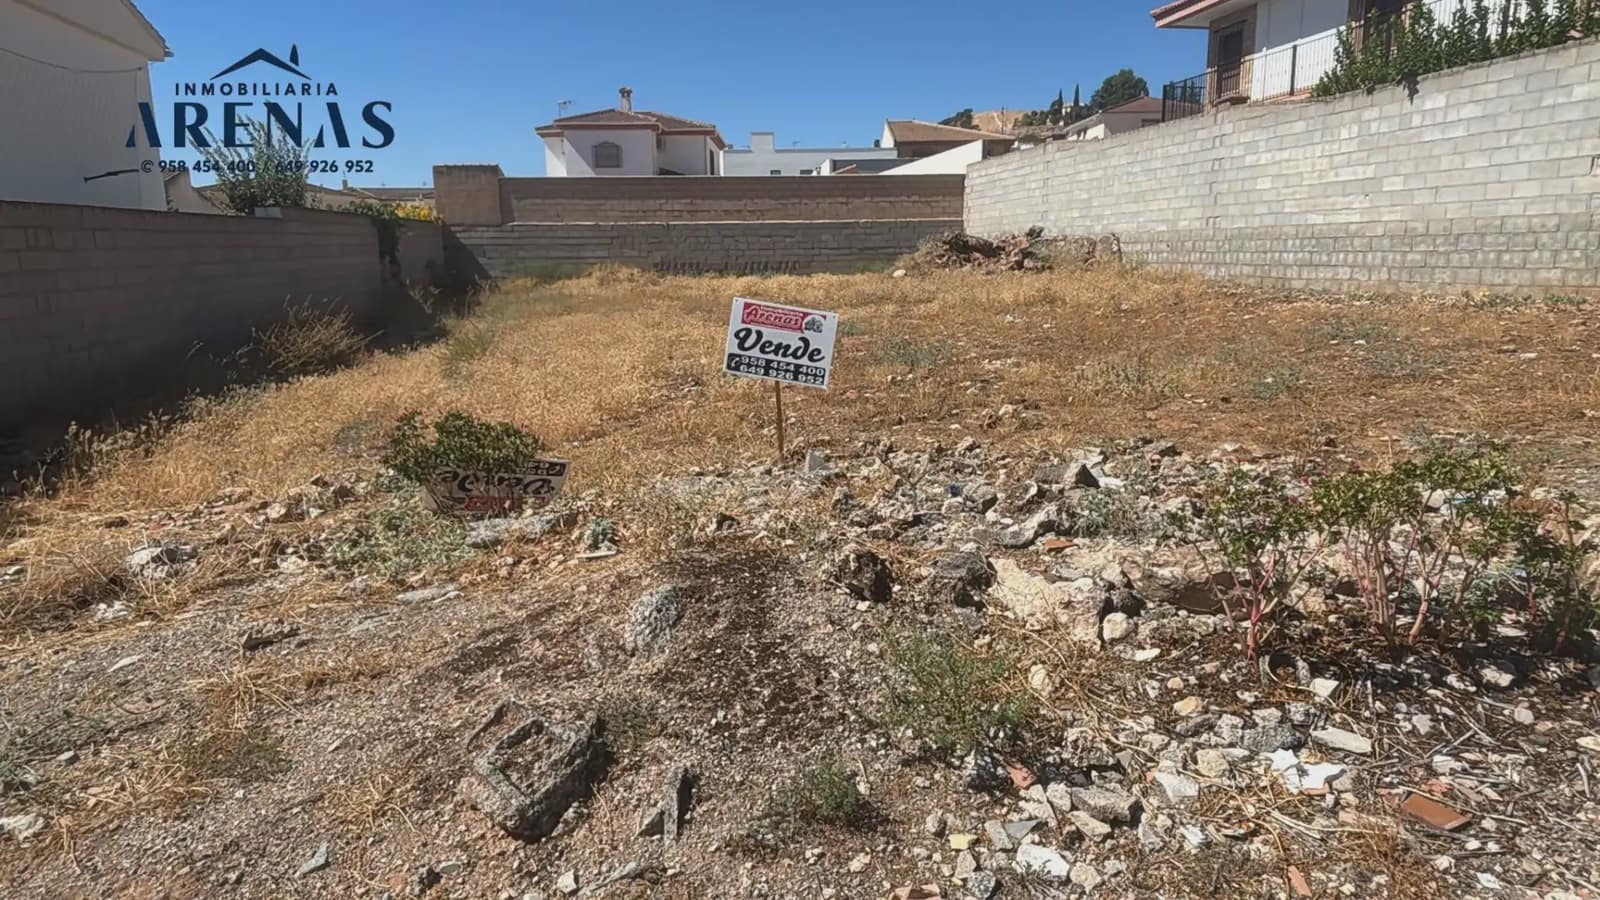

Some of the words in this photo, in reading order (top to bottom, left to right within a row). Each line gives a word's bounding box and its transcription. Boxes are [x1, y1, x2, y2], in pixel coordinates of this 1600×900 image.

[744, 305, 801, 326] Arenas
[734, 327, 826, 363] Vende
[739, 364, 765, 376] 649
[769, 369, 794, 380] 926
[798, 374, 823, 385] 952
[740, 356, 766, 366] 958
[770, 361, 795, 371] 454
[799, 366, 824, 376] 400
